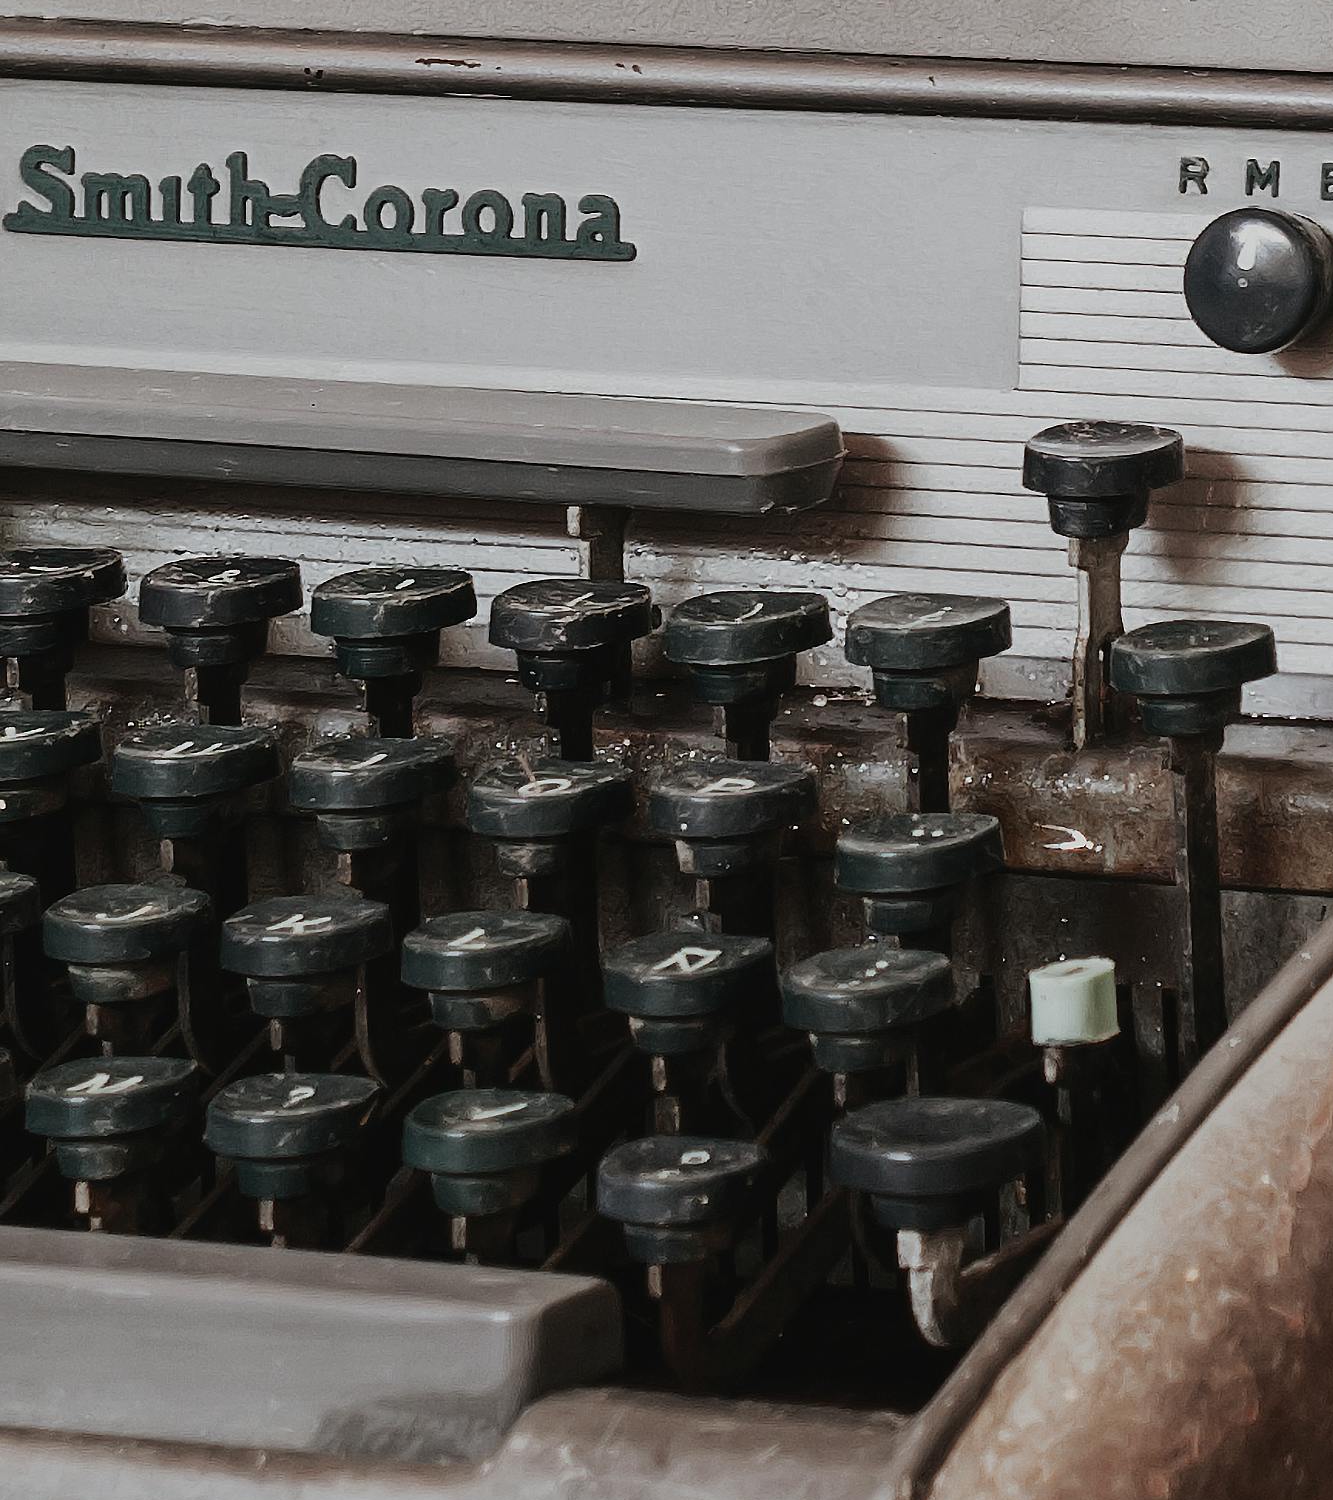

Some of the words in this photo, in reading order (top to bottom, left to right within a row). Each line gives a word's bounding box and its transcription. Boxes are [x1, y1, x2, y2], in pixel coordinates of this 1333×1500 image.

[1178, 156, 1210, 194] R
[1245, 159, 1280, 198] M
[6, 144, 636, 261] Smith-Corona
[697, 777, 756, 795] P
